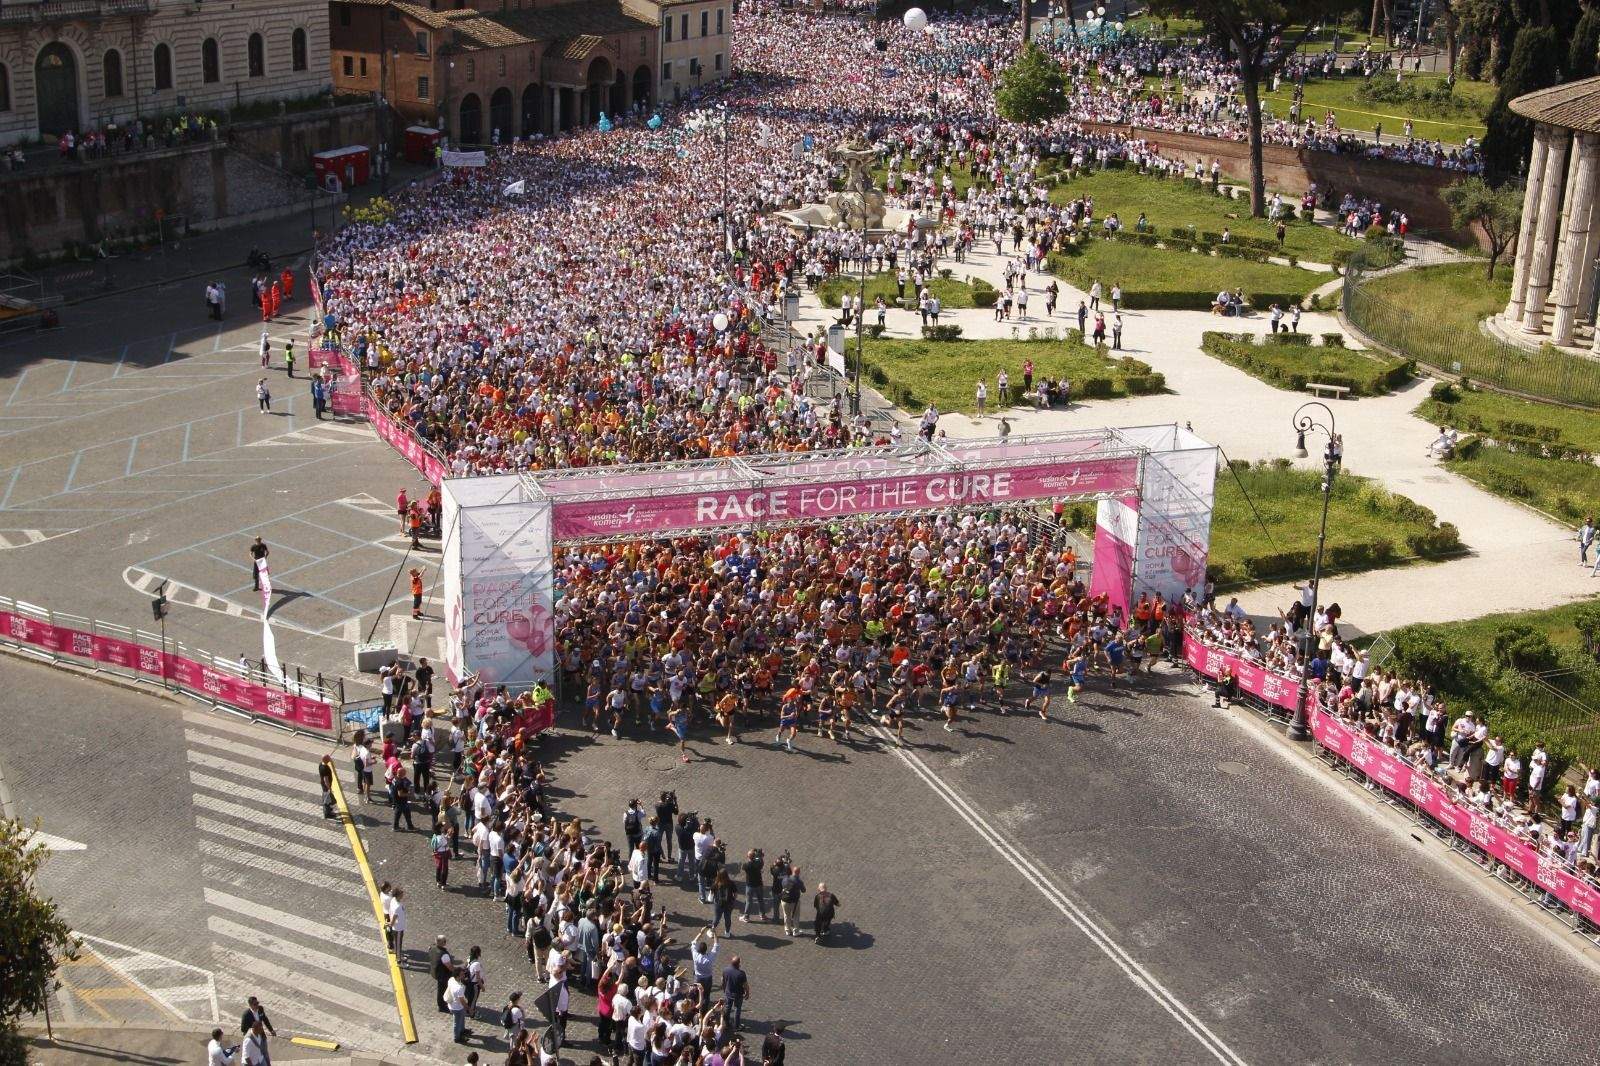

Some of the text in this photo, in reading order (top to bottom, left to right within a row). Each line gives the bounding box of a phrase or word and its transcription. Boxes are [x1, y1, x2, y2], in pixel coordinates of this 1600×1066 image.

[697, 490, 788, 522] RACE
[800, 486, 857, 513] FOR
[866, 480, 917, 508] THE
[925, 472, 1011, 502] CURE
[73, 632, 91, 641] RACE
[73, 645, 93, 655] CURE
[1264, 674, 1282, 687] RACE
[1262, 688, 1280, 700] CURE
